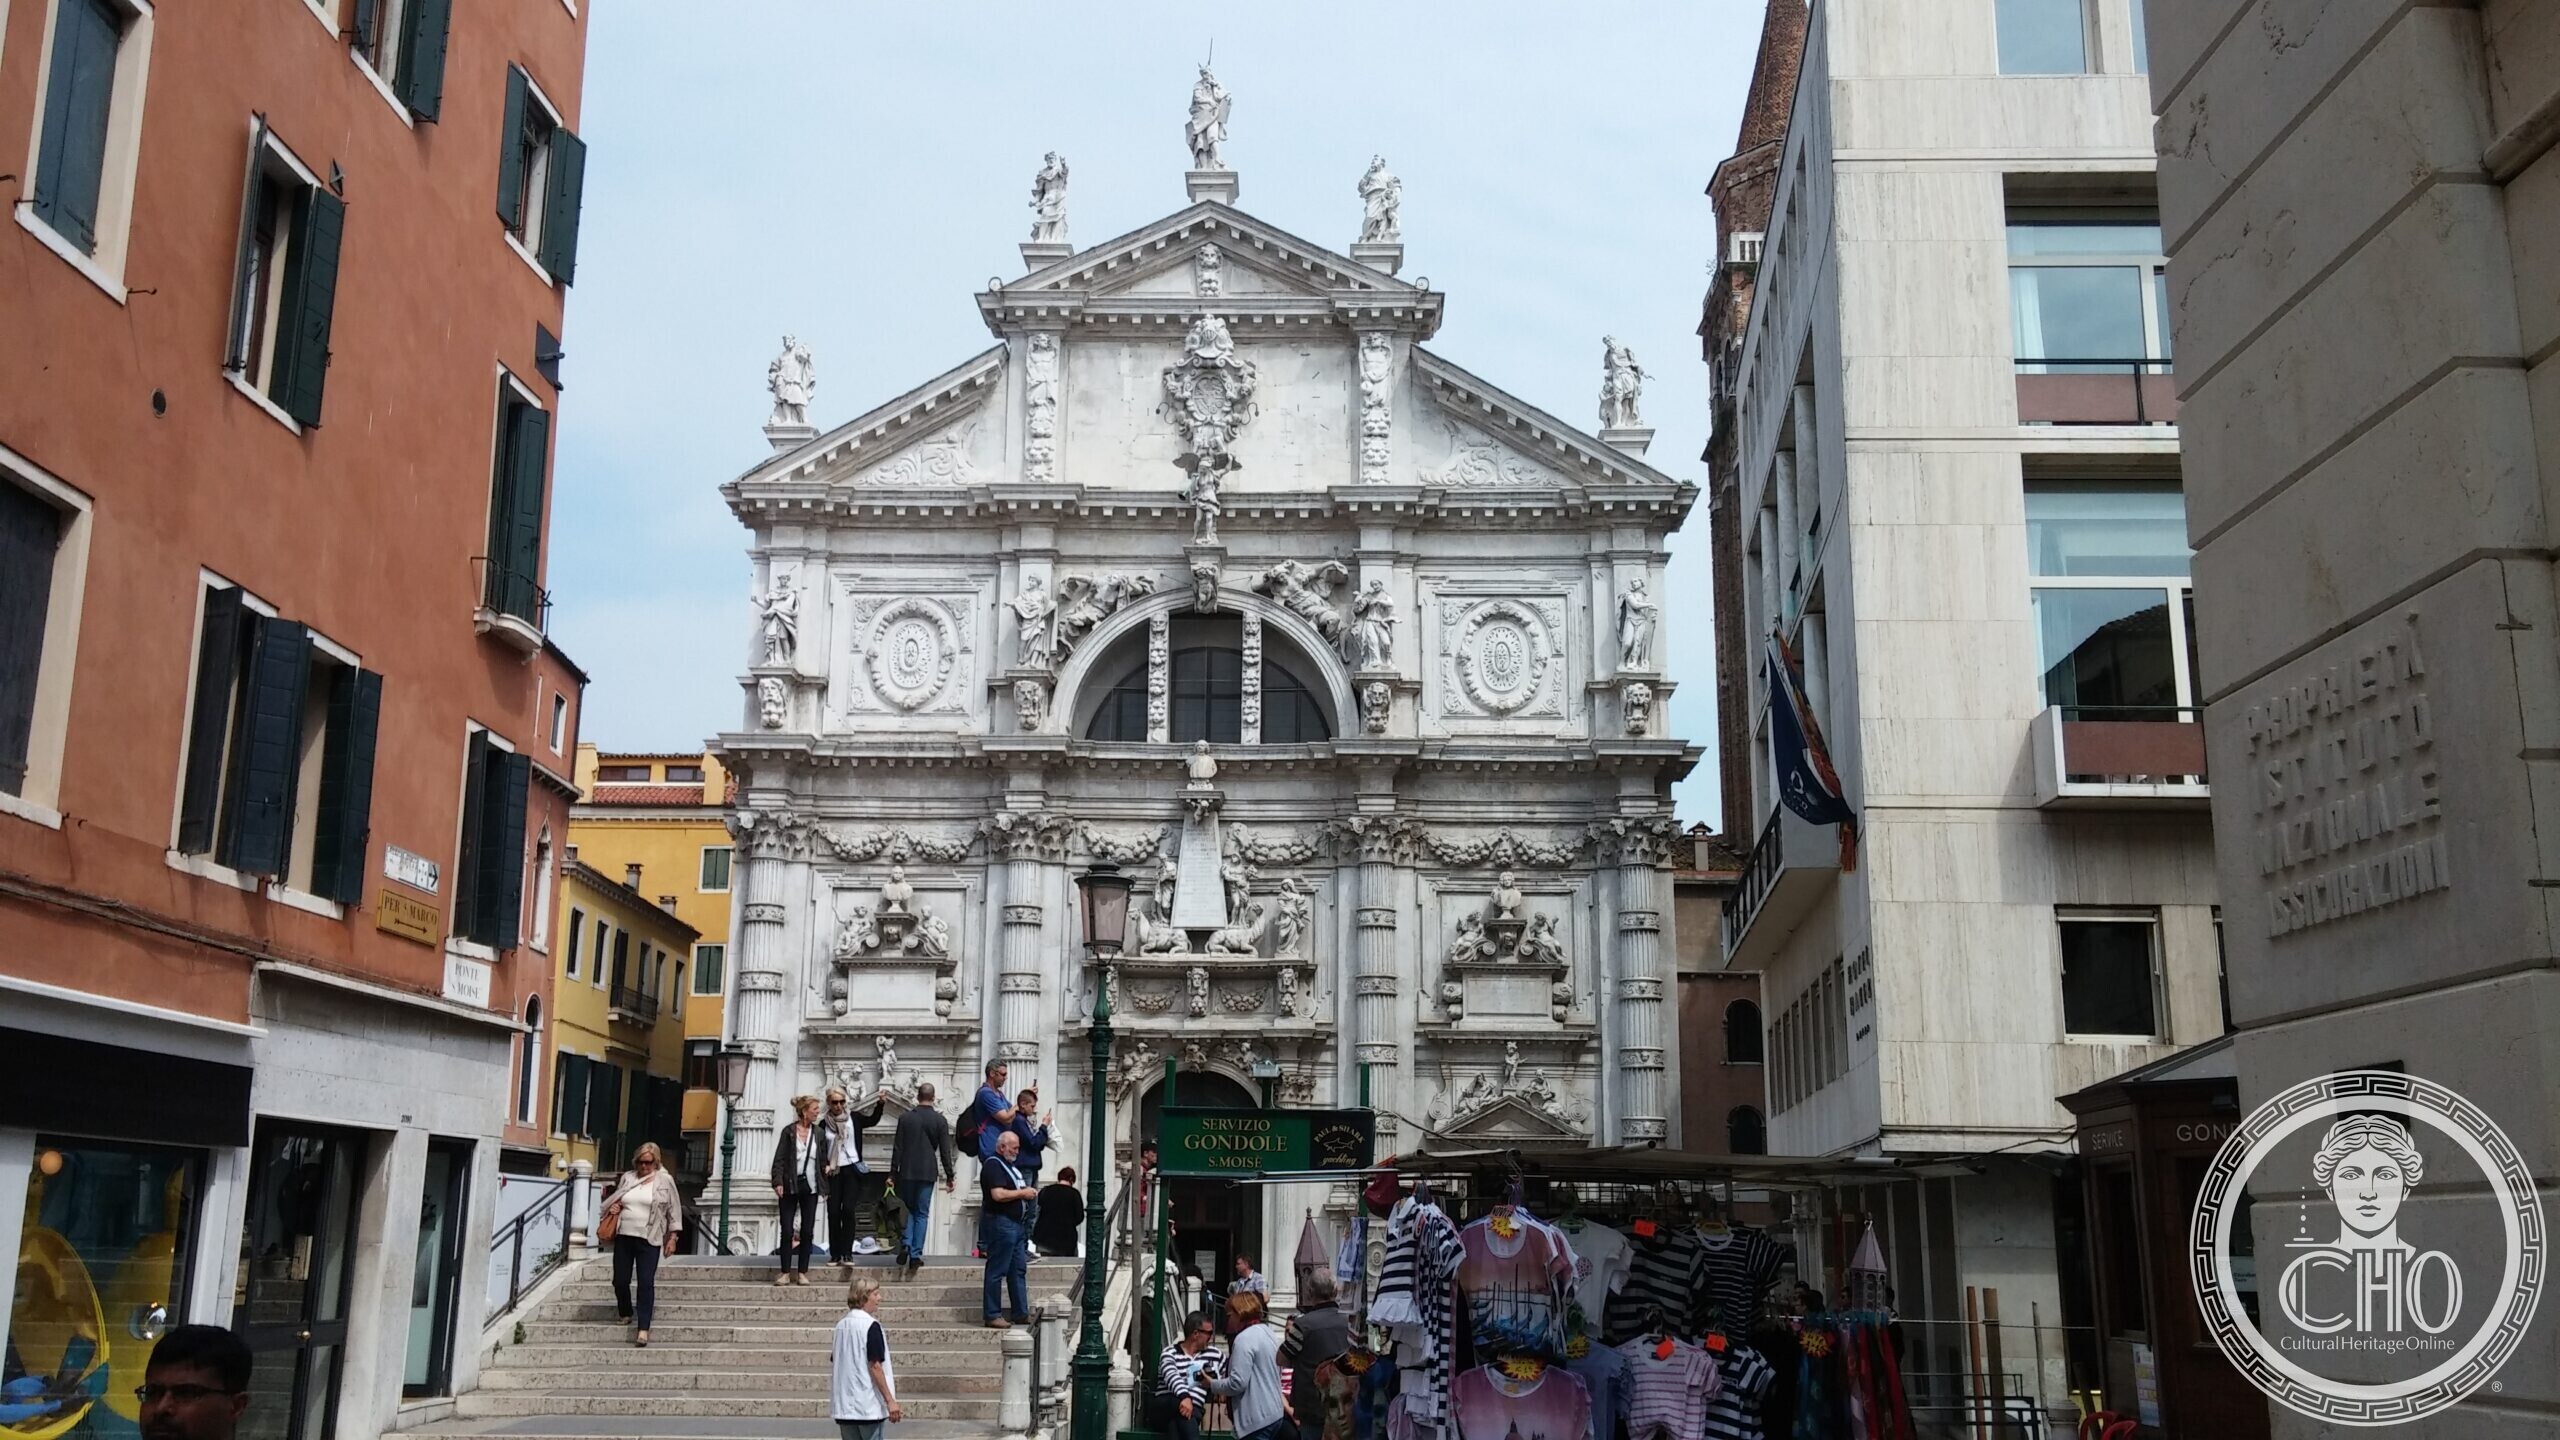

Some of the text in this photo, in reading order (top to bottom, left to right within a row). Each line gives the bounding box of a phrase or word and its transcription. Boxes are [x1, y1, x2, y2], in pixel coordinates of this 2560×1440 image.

[384, 895, 400, 914] PER
[410, 905, 438, 926] MARCO
[455, 963, 478, 981] PONTE
[1202, 1118, 1271, 1132] SERVIZIO
[1313, 1127, 1331, 1143] PAUL
[1338, 1124, 1366, 1144] SHARK
[1184, 1133, 1288, 1152] GONDOLE
[2091, 1129, 2124, 1151] SERVICE
